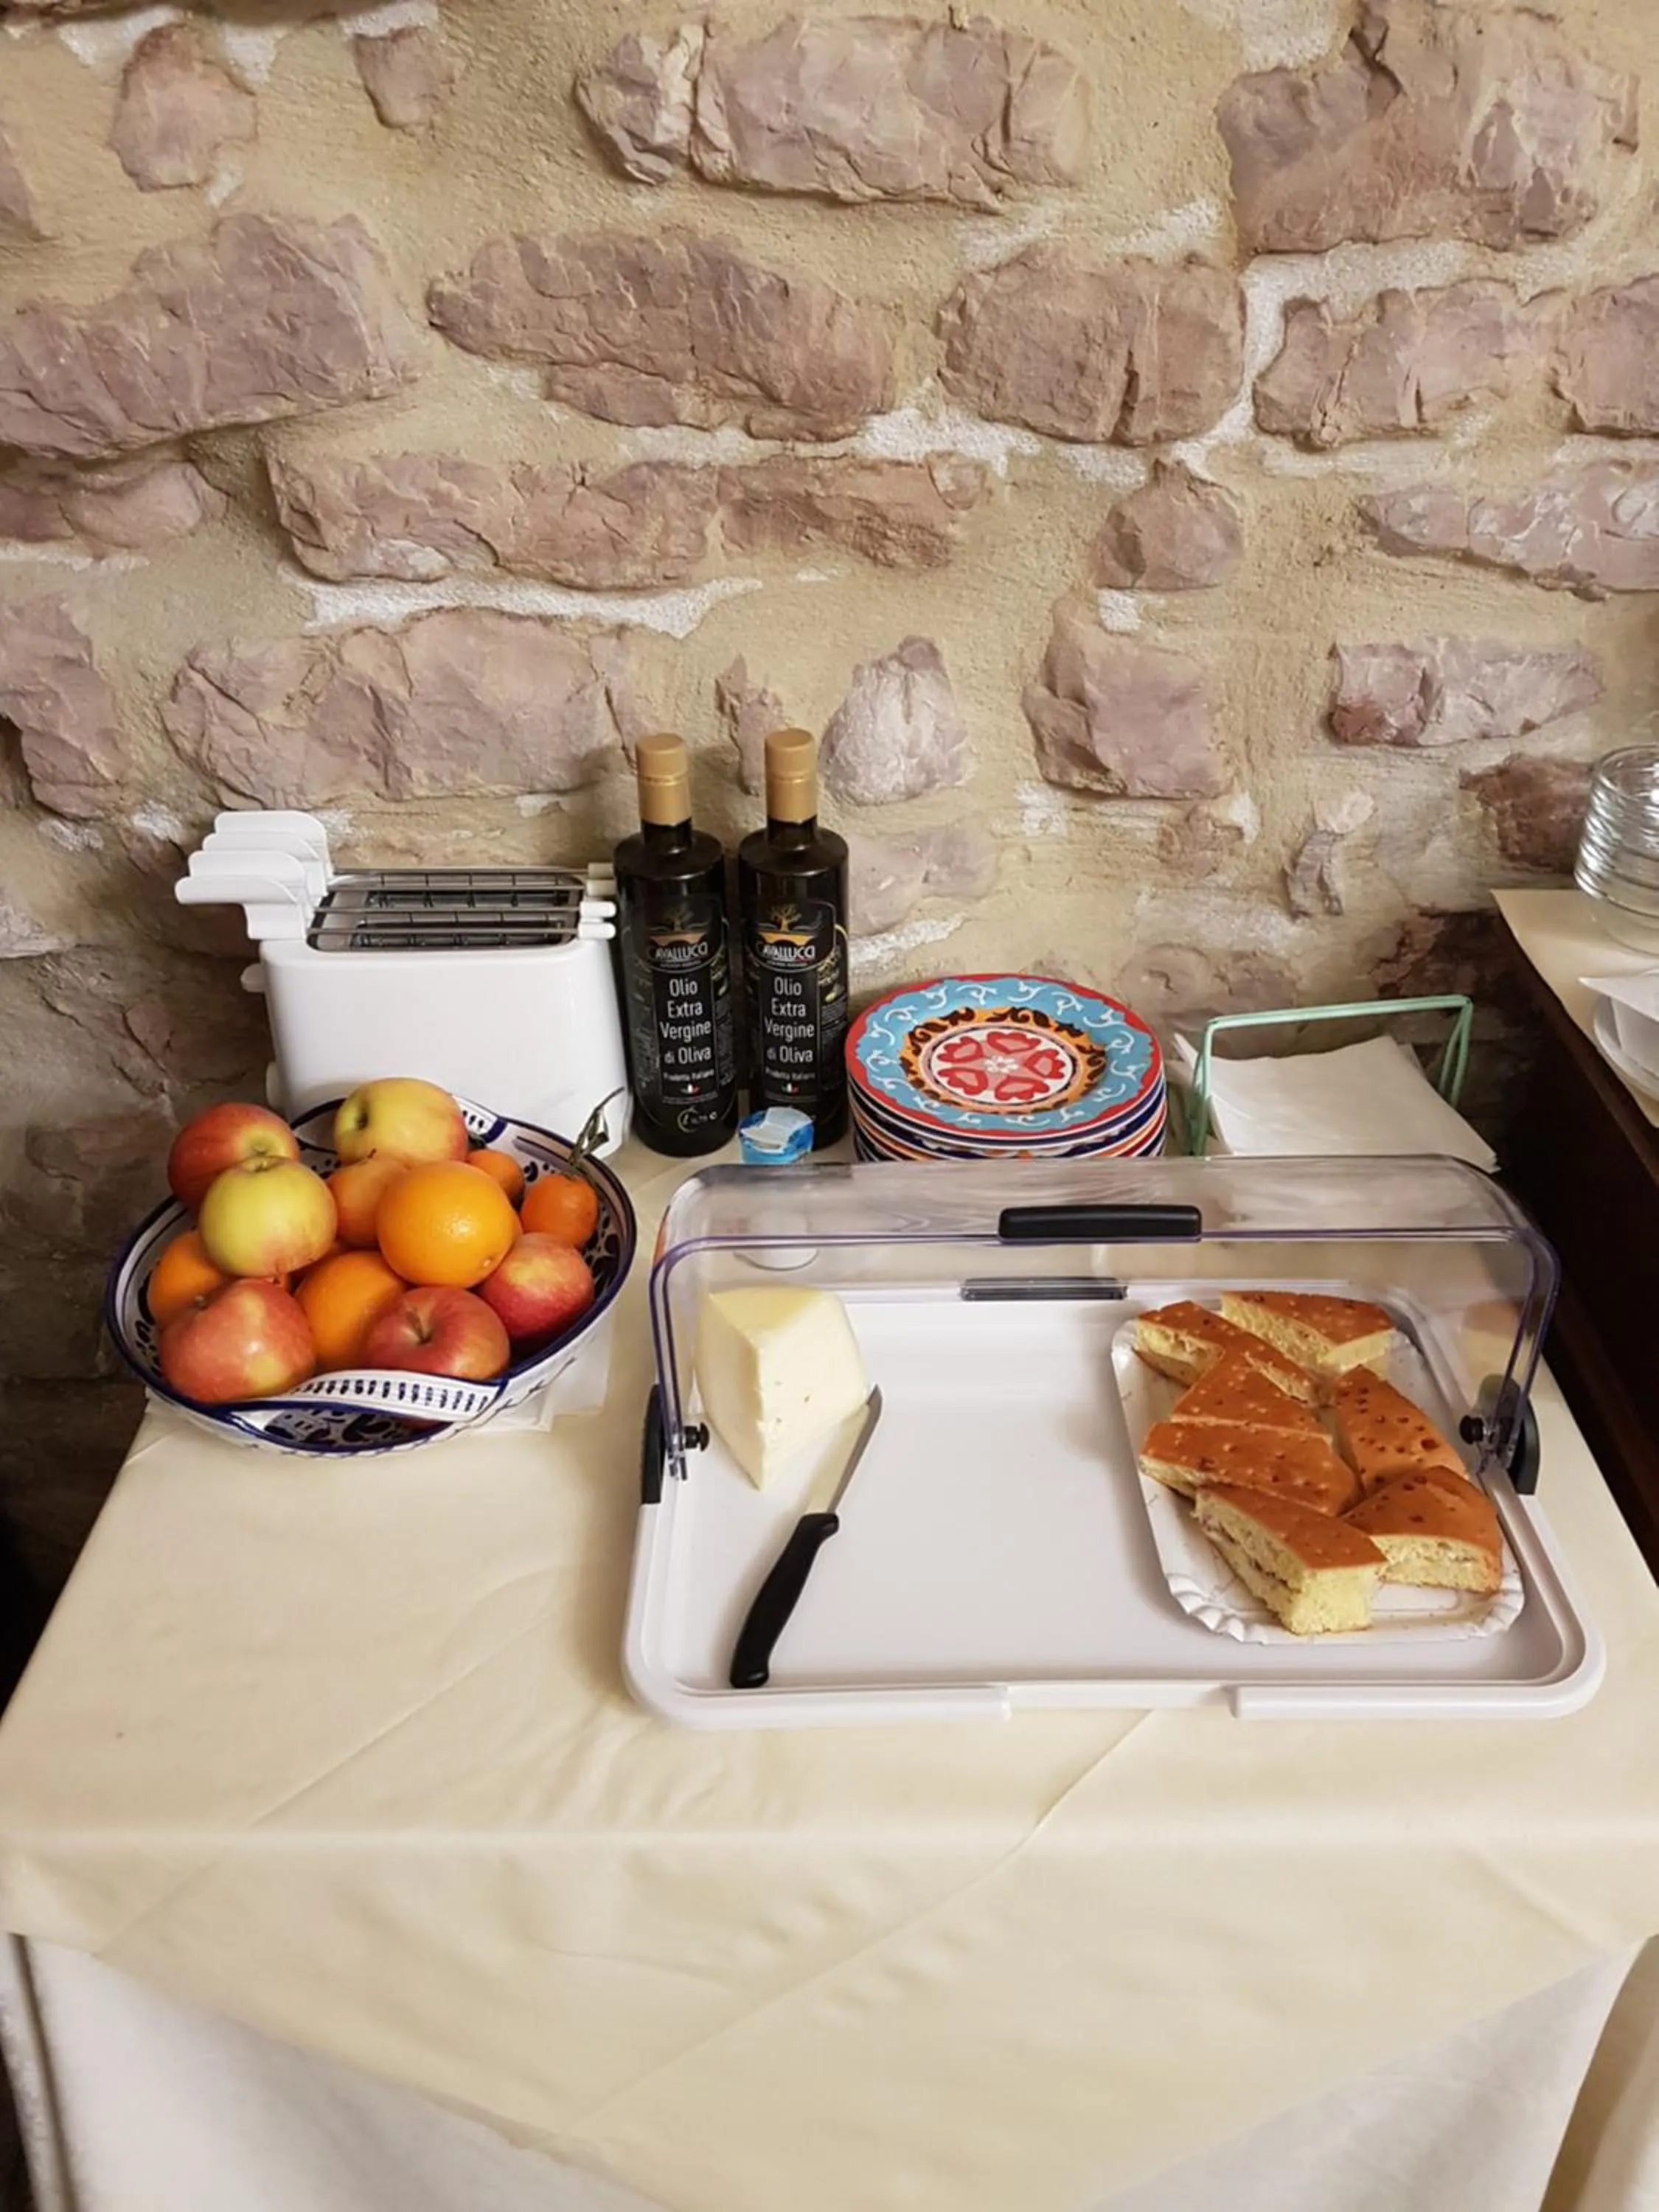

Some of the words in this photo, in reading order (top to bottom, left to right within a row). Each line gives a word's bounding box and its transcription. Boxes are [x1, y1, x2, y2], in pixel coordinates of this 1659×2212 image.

[669, 978, 698, 998] Olio
[773, 975, 802, 996] Olio
[667, 1000, 703, 1018] Extra
[771, 997, 807, 1017] Extra
[659, 1020, 712, 1043] Vergine
[764, 1016, 815, 1043] Vergine
[664, 1050, 675, 1064] di
[678, 1046, 712, 1064] Oliva
[779, 1045, 813, 1063] Oliva
